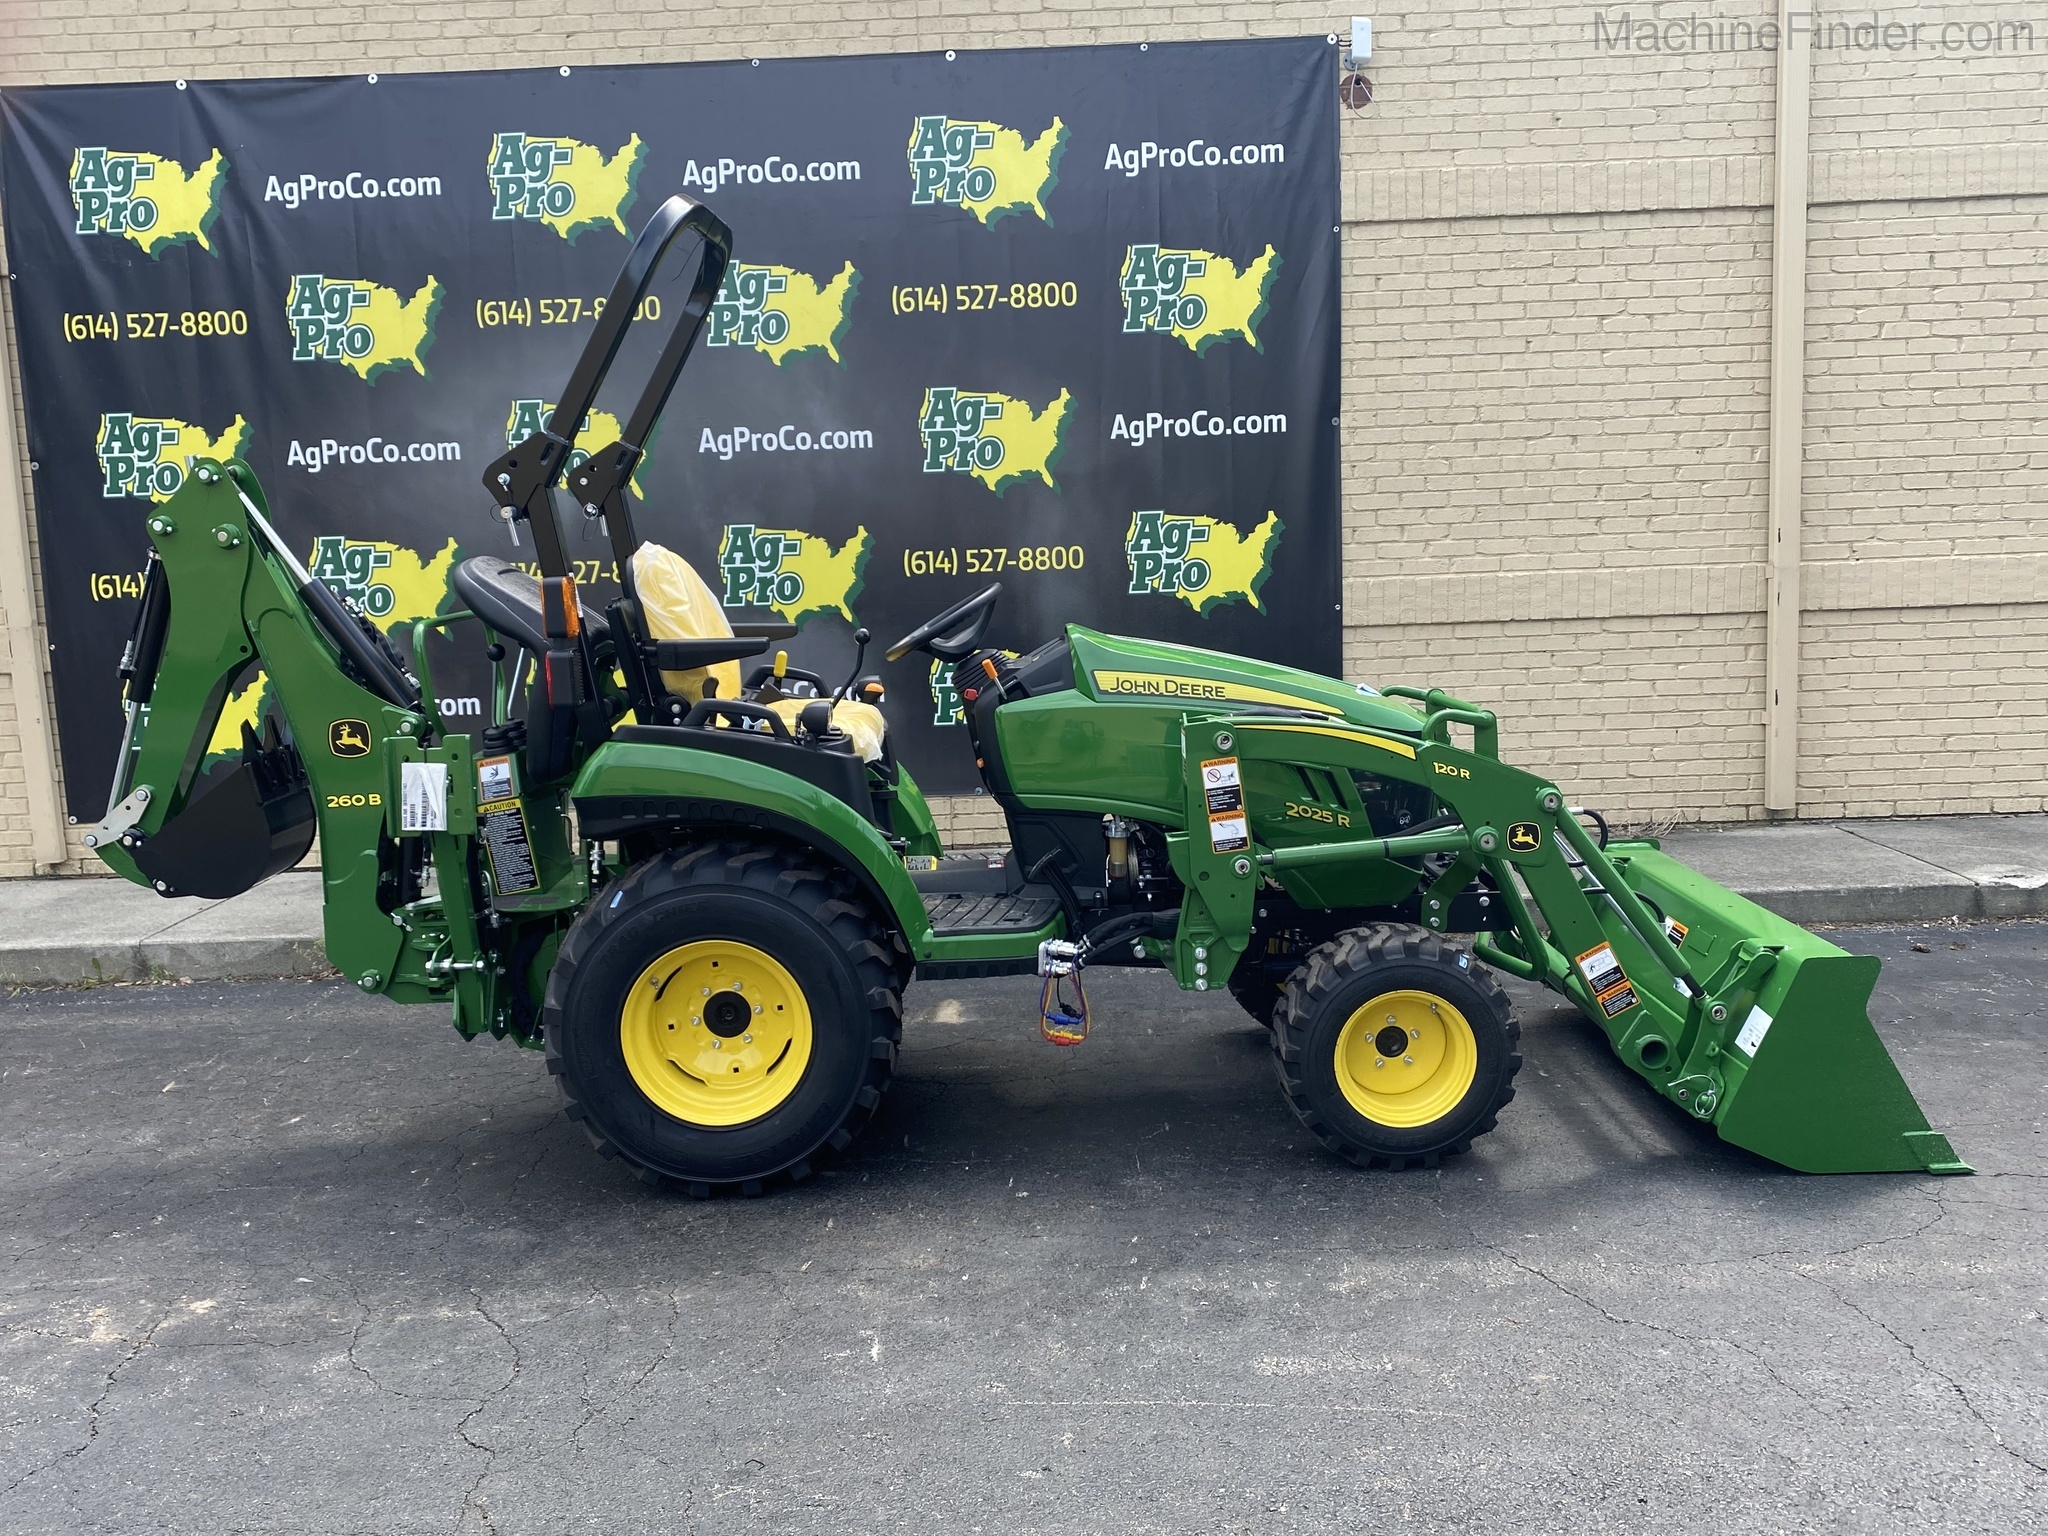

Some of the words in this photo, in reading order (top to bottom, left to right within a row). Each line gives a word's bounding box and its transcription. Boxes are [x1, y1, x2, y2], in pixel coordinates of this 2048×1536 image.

[490, 132, 572, 184] Ag-
[910, 115, 993, 168] Ag-
[1103, 139, 1285, 178] AgProCo.com
[72, 147, 154, 199] Ag-
[263, 171, 442, 210] AgProCo.com
[682, 155, 861, 191] AgProCo.com
[912, 159, 995, 204] Pro
[76, 190, 158, 234] Pro
[492, 175, 575, 219] Pro
[1122, 244, 1206, 297] Ag-
[288, 274, 370, 325] Ag-
[476, 297, 532, 329] (614)
[892, 287, 947, 315] (614)
[957, 282, 1077, 310] 527-8800
[1123, 286, 1206, 332] Pro
[63, 314, 118, 340] (614)
[126, 310, 247, 338] 527-8800
[292, 317, 374, 360] Pro
[707, 302, 789, 347] Pro
[921, 387, 1002, 438] Ag-
[1110, 410, 1287, 447] AgProCo.com
[99, 413, 179, 464] Ag-
[286, 437, 462, 473] AgProCo.com
[698, 424, 874, 461] AgProCo.com
[923, 429, 1004, 472] Pro
[103, 454, 183, 497] Pro
[721, 524, 801, 575] Ag-
[1127, 510, 1209, 561] Ag-
[311, 535, 391, 584] Ag-
[903, 549, 959, 576] (614)
[966, 545, 1085, 573] 527-8800
[1129, 551, 1210, 593] Pro
[90, 571, 146, 602] (614)
[723, 565, 803, 607] Pro
[1110, 677, 1160, 693] JOHN
[1164, 680, 1226, 698] DEERE
[1207, 758, 1236, 767] WARNING
[1432, 762, 1458, 777] 120
[1460, 767, 1471, 780] R
[326, 794, 366, 808] 260
[368, 793, 382, 806] B
[489, 801, 516, 812] CAUTION
[1215, 812, 1244, 822] WARNING
[1284, 802, 1334, 824] 2025
[1337, 813, 1351, 828] R
[1585, 944, 1606, 957] WARNING
[1607, 985, 1628, 997] WARNING
